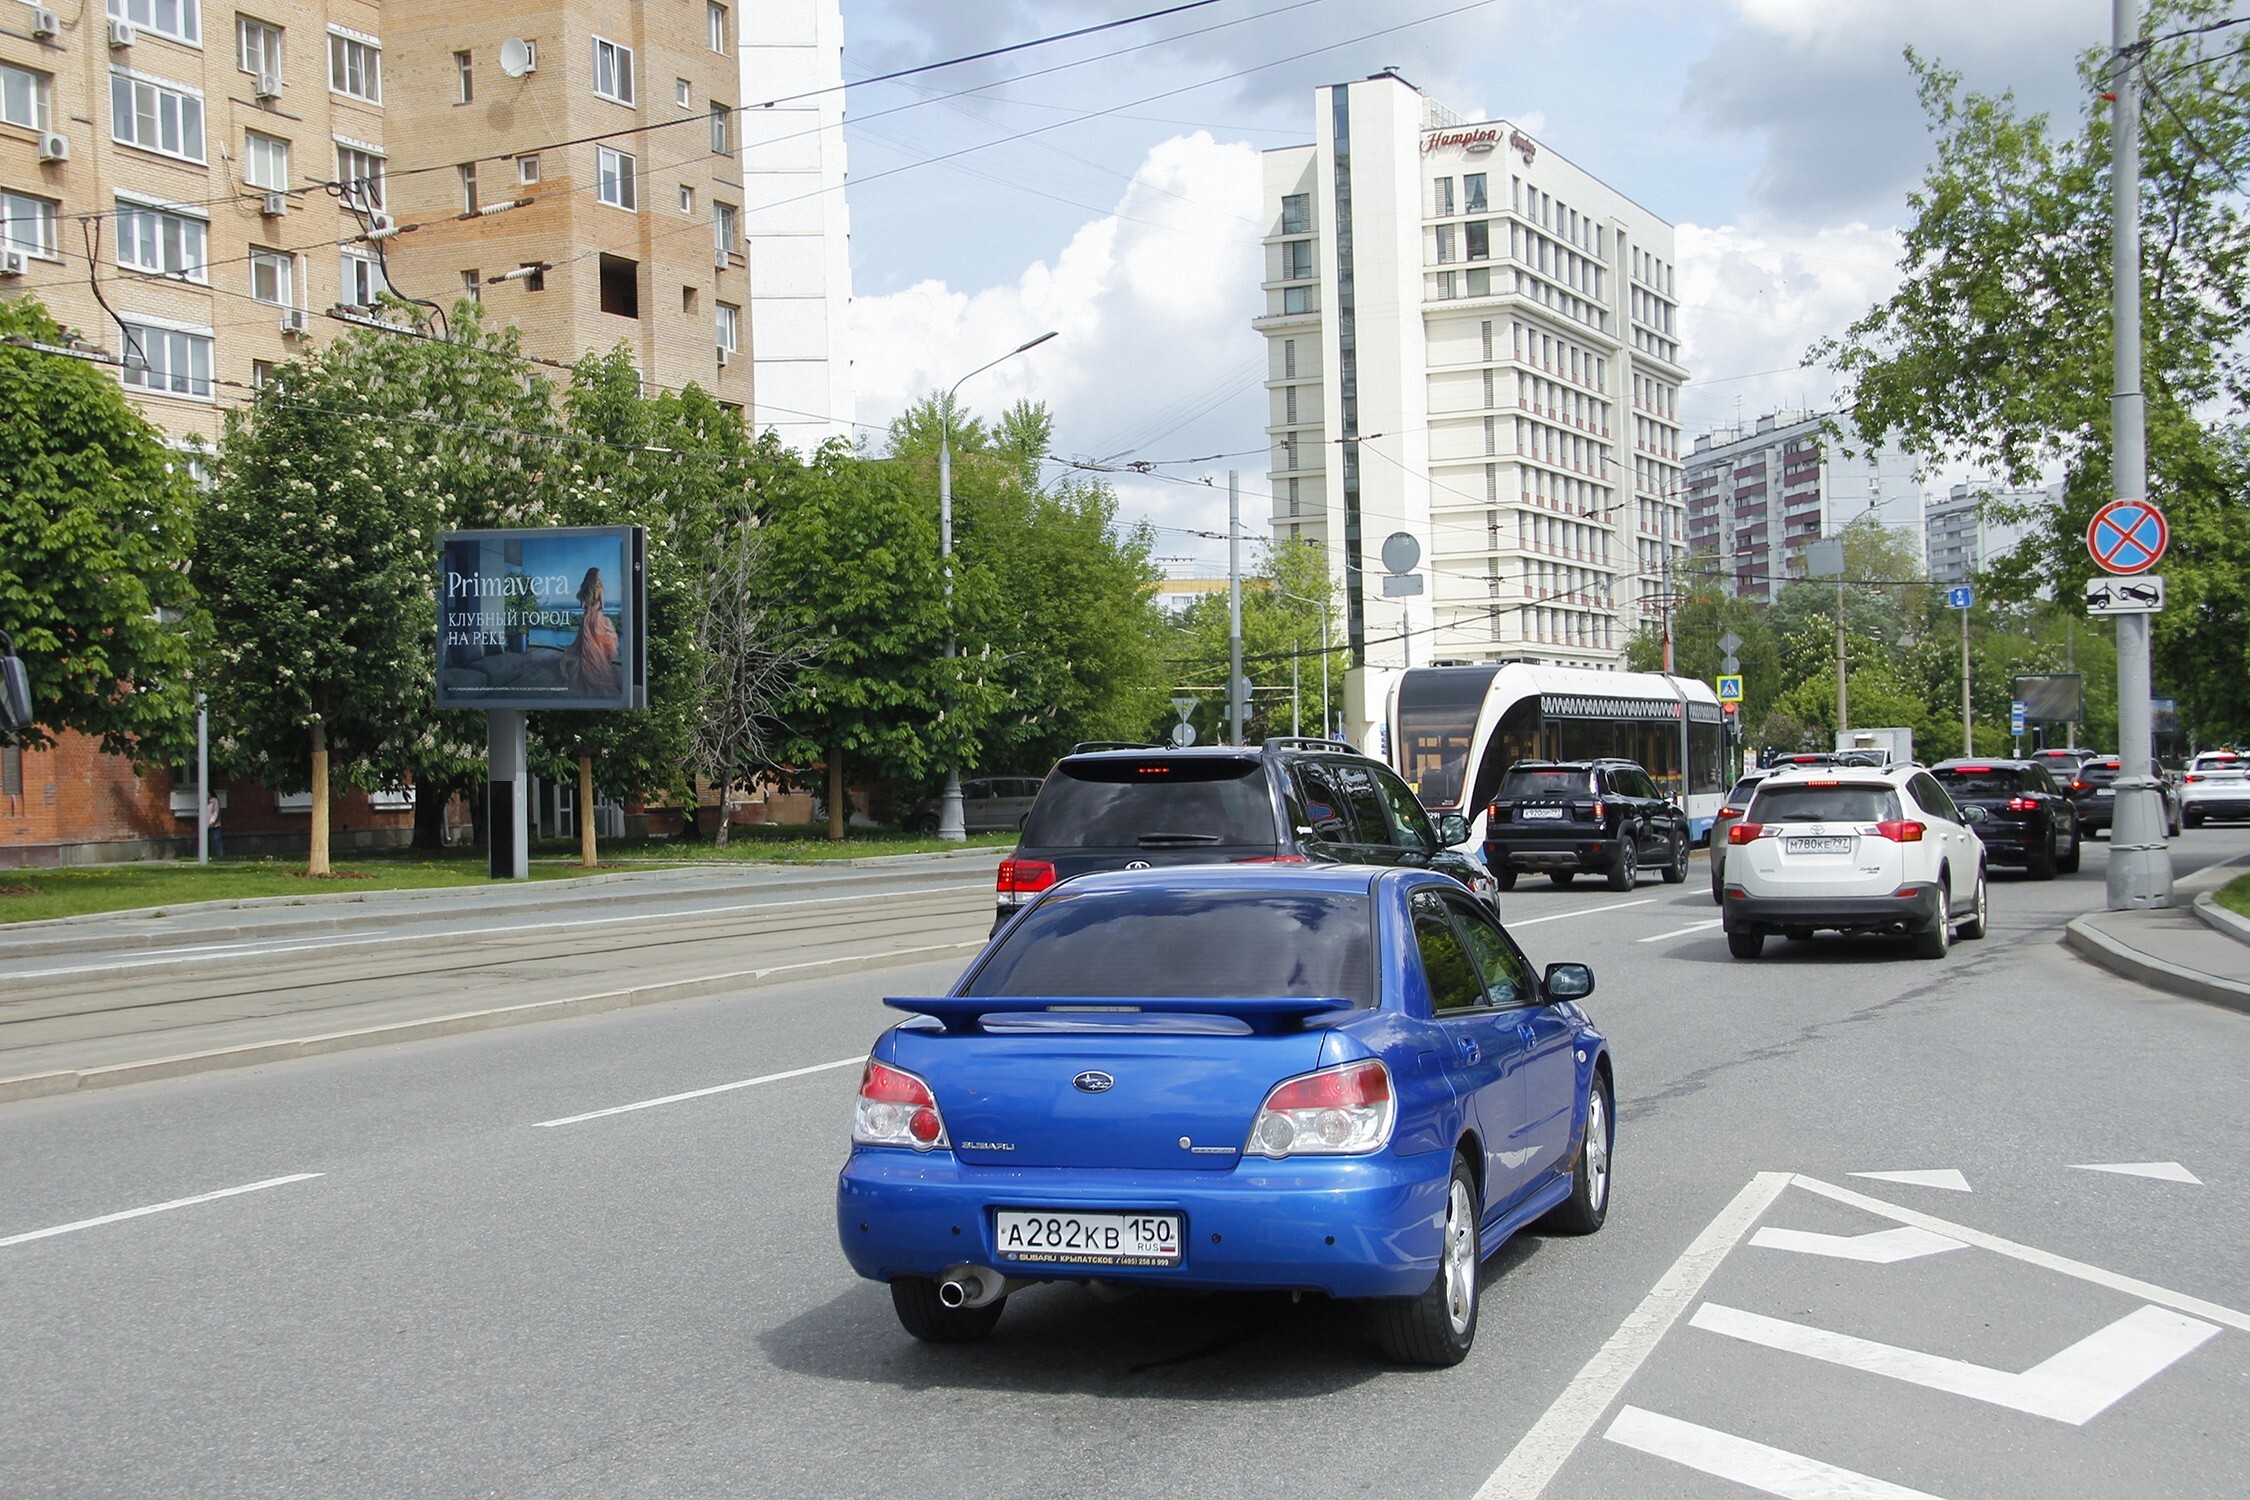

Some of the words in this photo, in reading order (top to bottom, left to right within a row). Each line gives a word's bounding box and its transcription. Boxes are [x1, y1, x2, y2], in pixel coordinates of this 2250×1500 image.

[1420, 129, 1503, 153] Hampton
[448, 571, 570, 597] Primavera
[448, 609, 517, 627] КЛУБНЫЙ
[521, 610, 571, 627] ГОРОД
[448, 631, 469, 645] НА
[473, 631, 506, 645] РЕКЕ
[961, 1141, 1015, 1150] SUBARU
[1128, 1219, 1171, 1242] 150
[1137, 1243, 1159, 1251] RUS
[1019, 1253, 1056, 1261] SUBARU
[1060, 1255, 1113, 1264] КРЫЛАТСКОЕ
